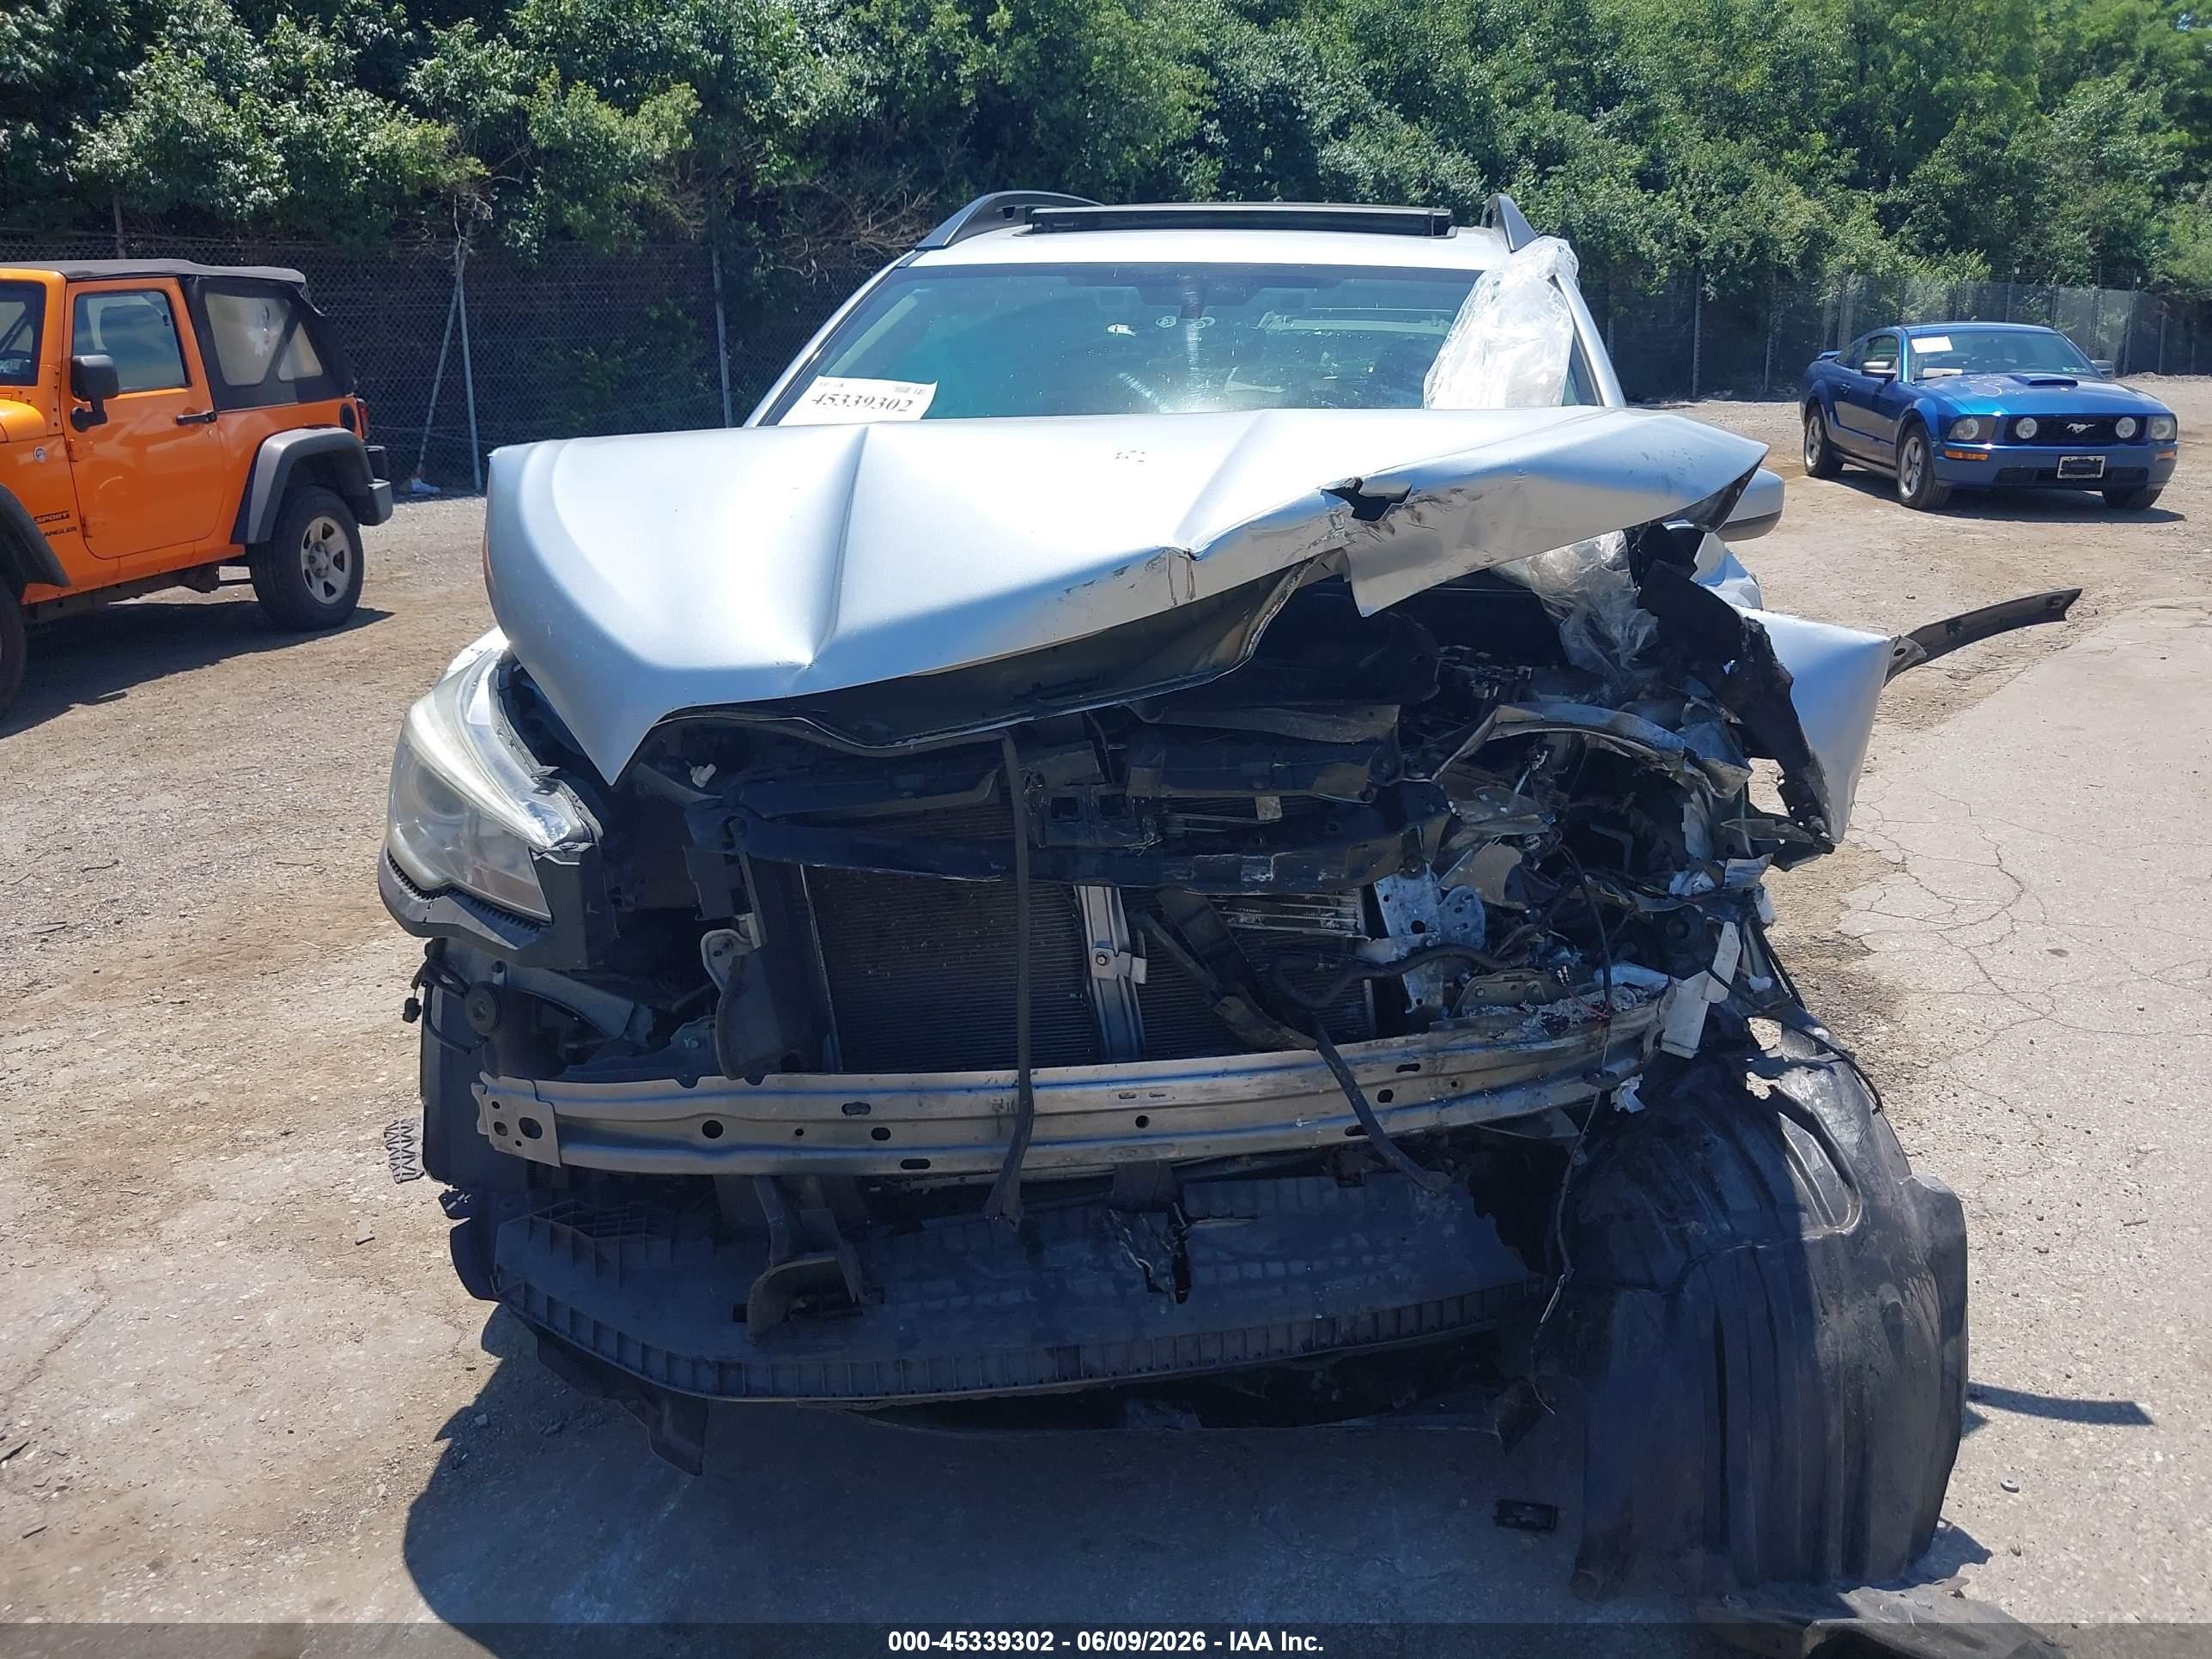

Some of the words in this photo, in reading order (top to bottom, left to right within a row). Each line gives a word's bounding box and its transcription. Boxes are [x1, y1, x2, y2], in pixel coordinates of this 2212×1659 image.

[811, 392, 914, 412] 45339302
[35, 513, 69, 523] SPORT
[44, 526, 77, 537] ANGLER
